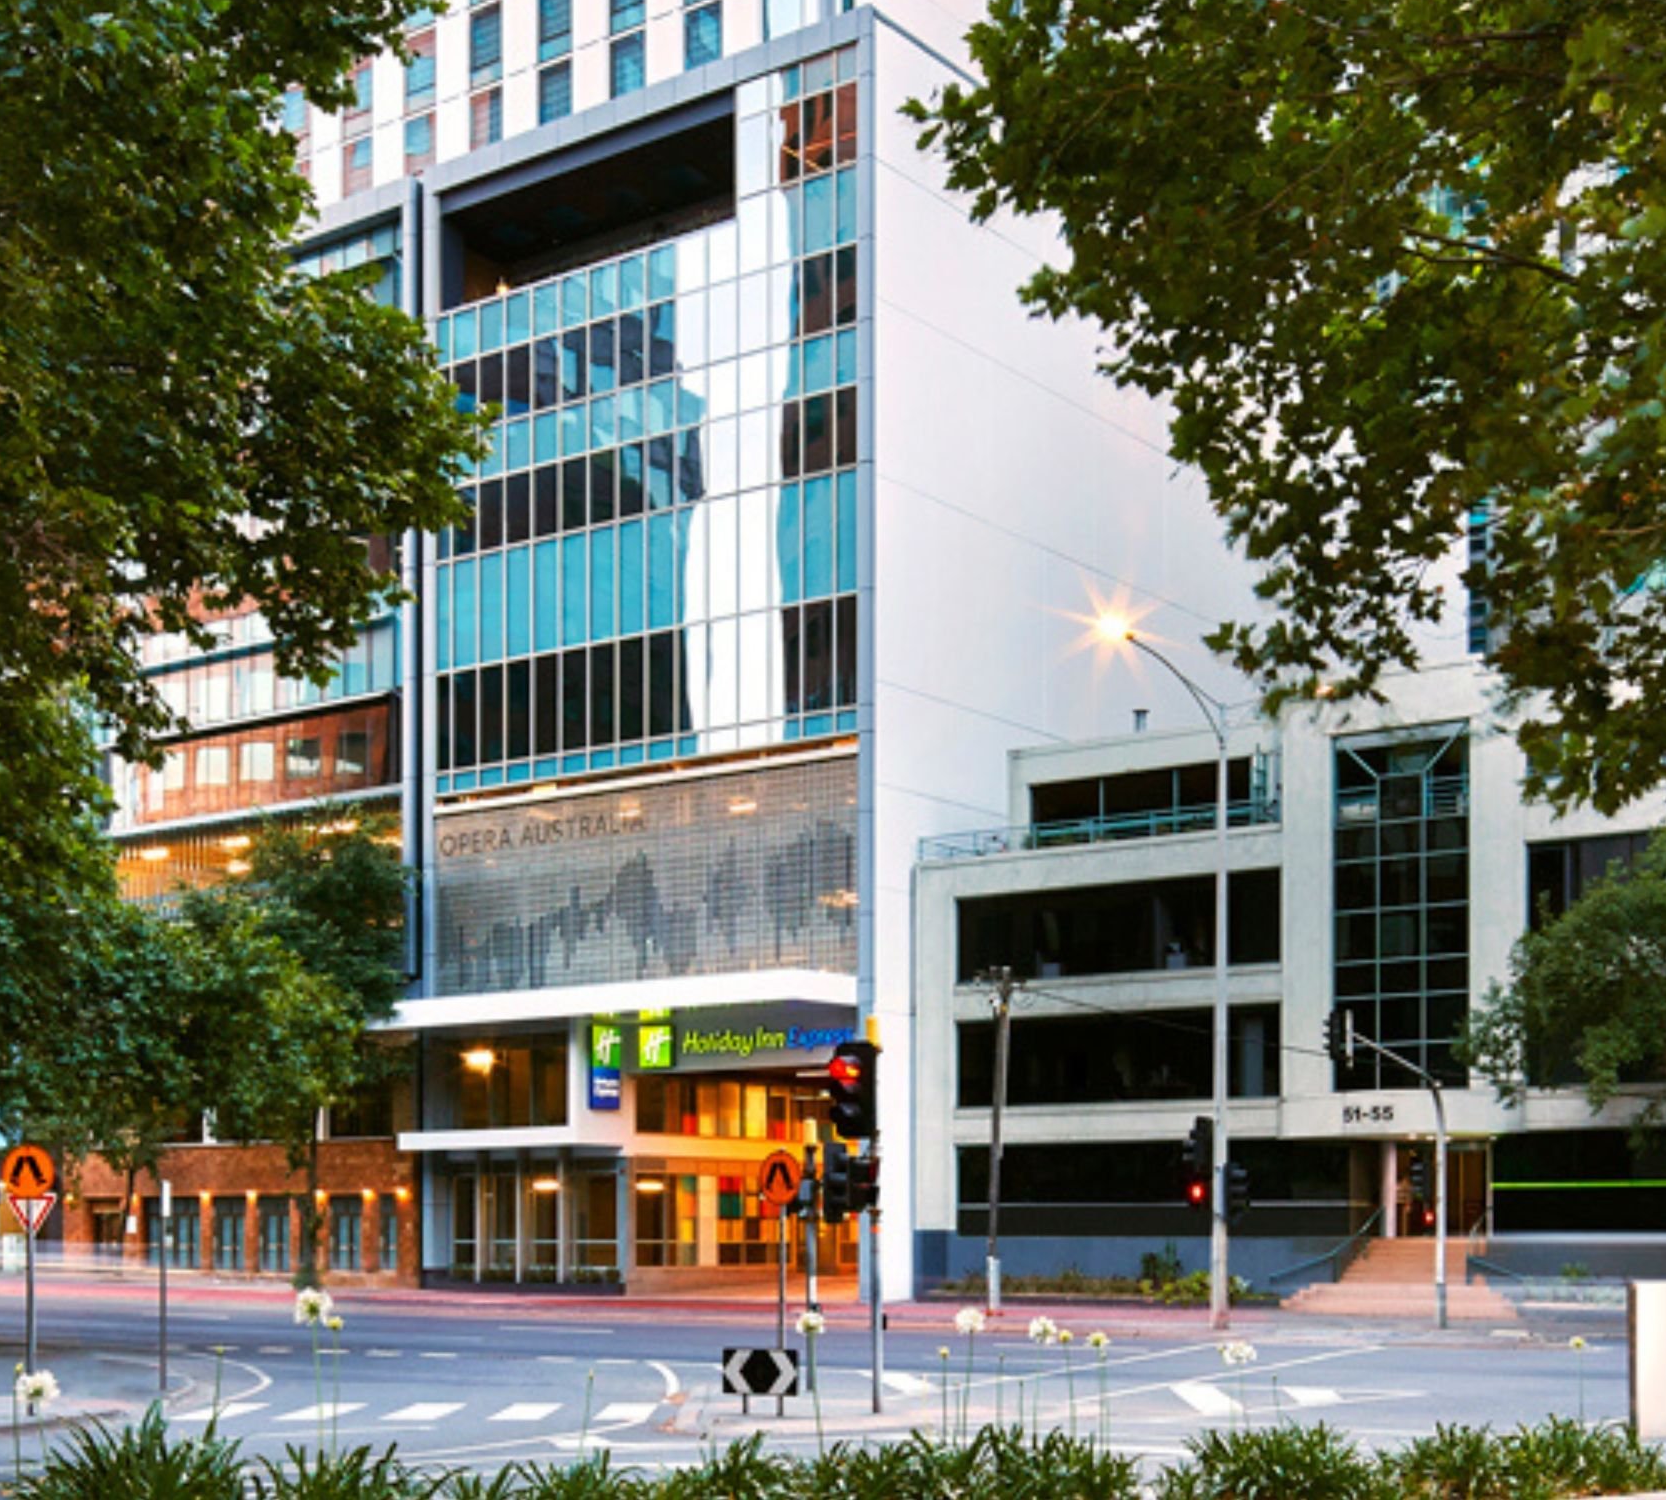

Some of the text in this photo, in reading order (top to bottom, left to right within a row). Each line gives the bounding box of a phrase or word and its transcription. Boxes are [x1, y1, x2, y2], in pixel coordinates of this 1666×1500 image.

[440, 828, 512, 857] OPERA
[683, 1024, 855, 1057] Holiday Inn Express
[1342, 1104, 1395, 1124] 51-55
